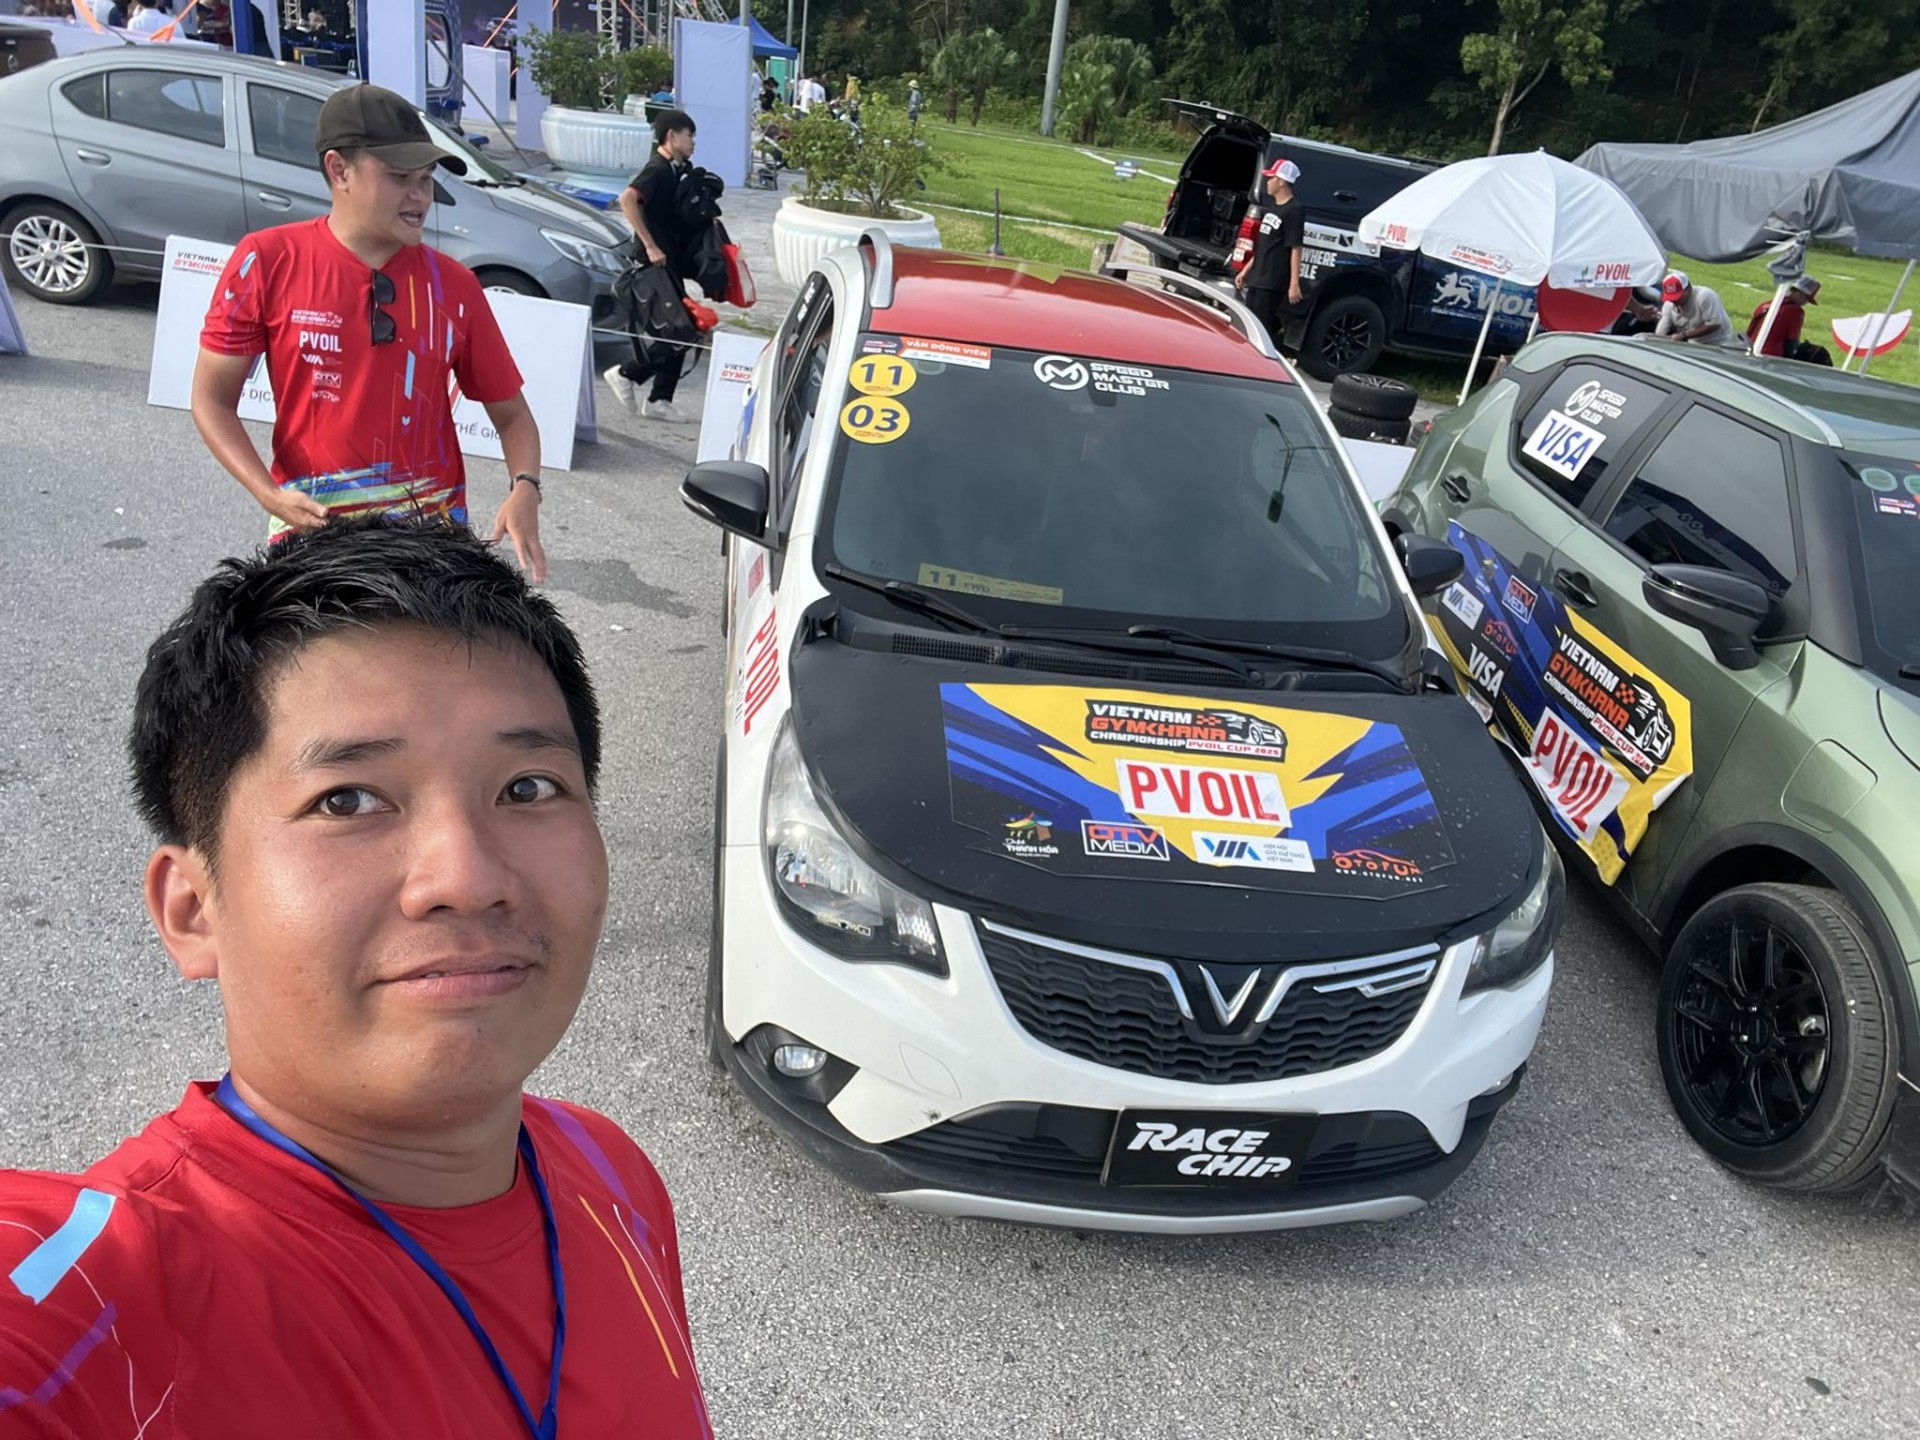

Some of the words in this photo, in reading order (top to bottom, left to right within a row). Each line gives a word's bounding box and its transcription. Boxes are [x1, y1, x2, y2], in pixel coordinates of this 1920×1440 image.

[1386, 224, 1408, 243] PVOIL
[176, 251, 219, 264] VIETNAM
[1594, 263, 1632, 281] PVOIL
[299, 330, 343, 353] PVOIL
[962, 346, 988, 358] VIÊN
[860, 362, 903, 386] 11
[1089, 362, 1154, 379] SPEED
[1091, 371, 1170, 391] MASTER
[1094, 381, 1147, 397] CLUB
[847, 404, 901, 433] 03
[1588, 400, 1623, 420] MASTER
[1537, 417, 1595, 472] VISA
[929, 570, 958, 587] 11
[743, 606, 781, 737] PVOIL
[1468, 641, 1505, 698] VISA
[1559, 633, 1620, 693] VIETNAM
[1550, 652, 1630, 731] GYMKHANA
[1092, 703, 1193, 725] VIETNAM
[1543, 671, 1596, 721] CHAMPIONSHIP
[1593, 715, 1616, 742] PVOIL
[1615, 736, 1636, 759] CUP
[1090, 716, 1228, 742] GYMKHANA
[1089, 730, 1186, 748] CHAMPIONSHIP
[1187, 740, 1224, 752] PVOIL
[1226, 743, 1252, 753] CUP
[1531, 716, 1614, 834] PVOIL
[1126, 763, 1281, 822] PVOIL
[1089, 838, 1166, 859] MEDIA
[1335, 856, 1421, 877] OTOFUN
[1127, 1122, 1271, 1154] RACE
[1177, 1154, 1292, 1178] CHIP
